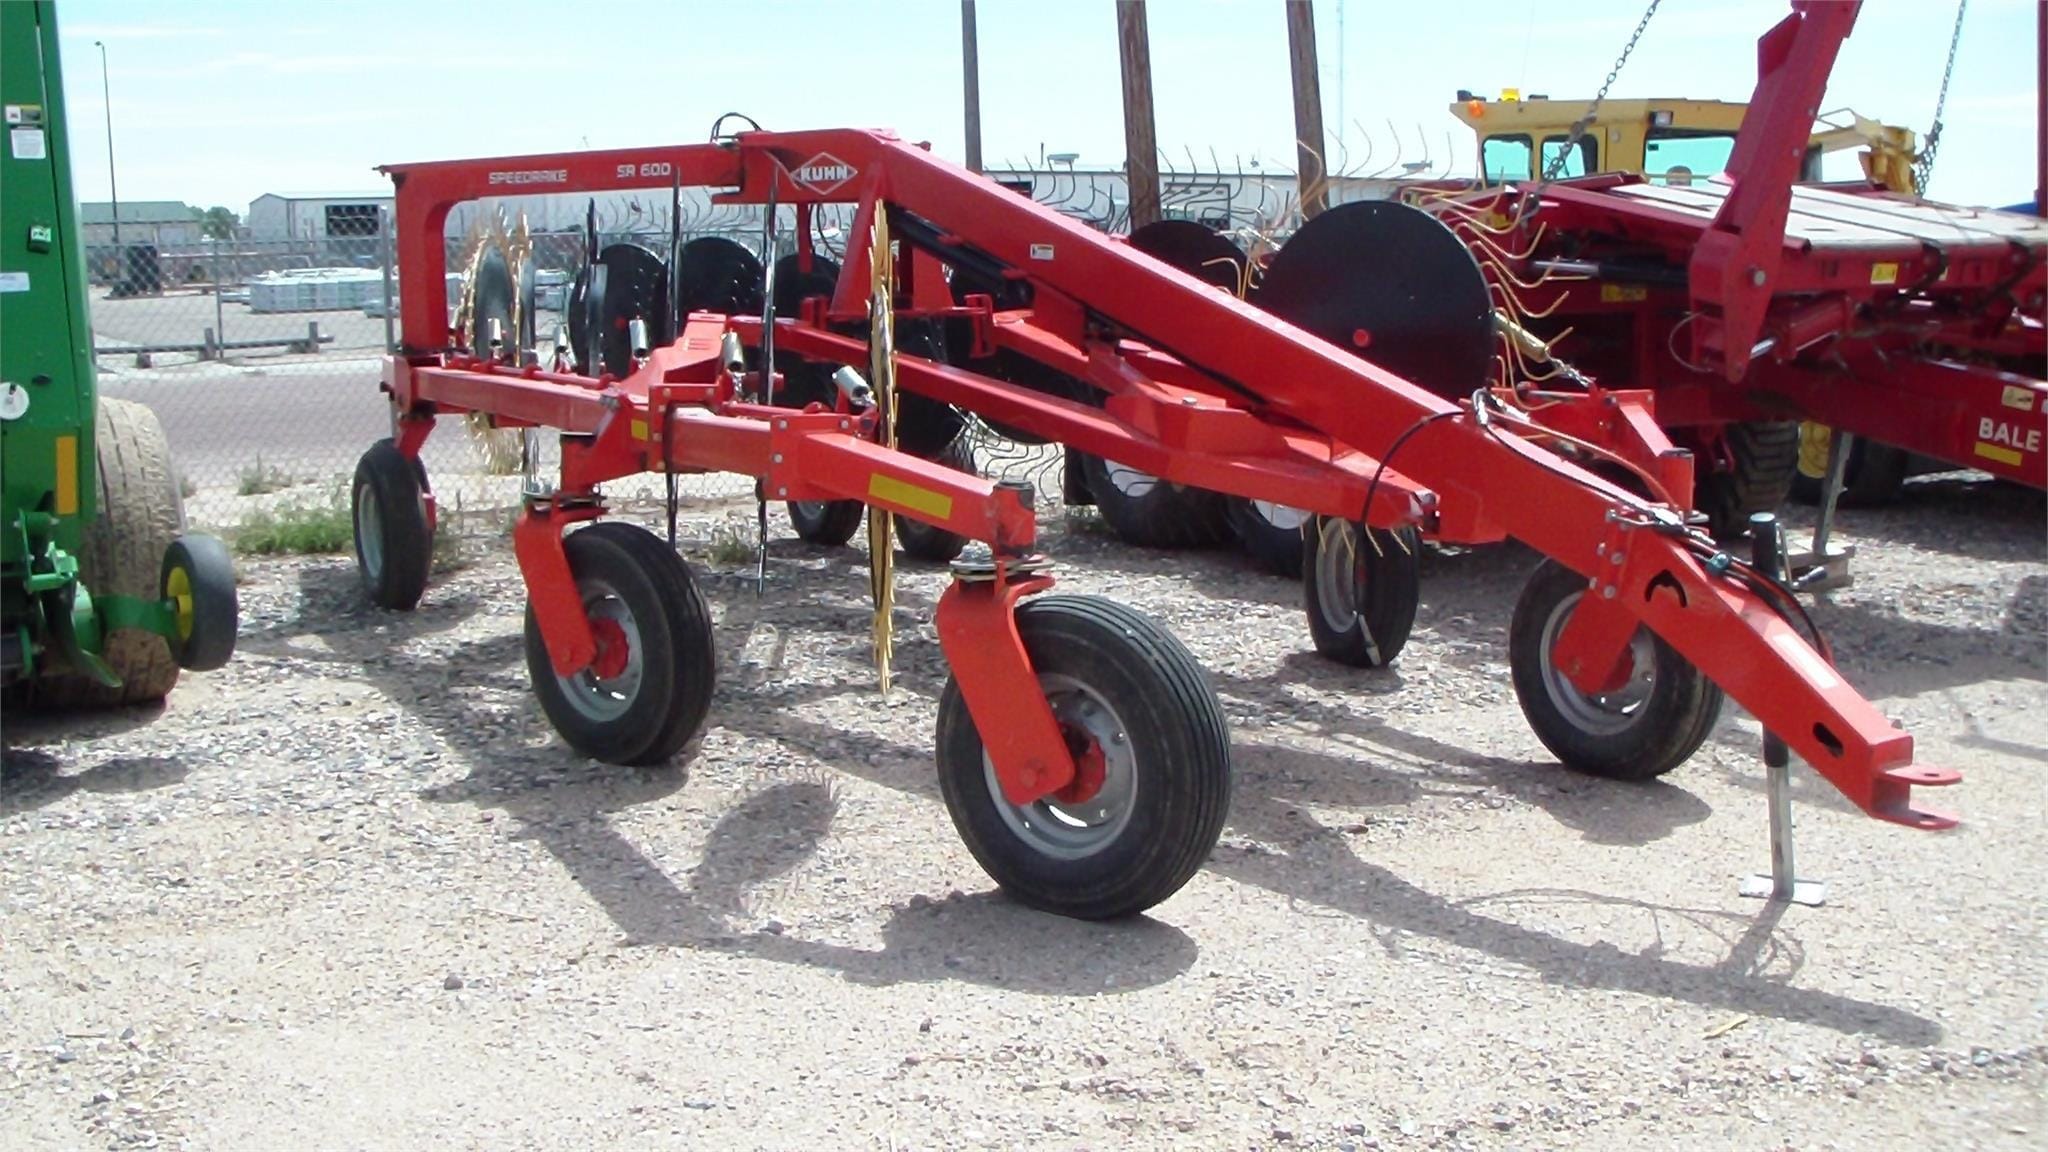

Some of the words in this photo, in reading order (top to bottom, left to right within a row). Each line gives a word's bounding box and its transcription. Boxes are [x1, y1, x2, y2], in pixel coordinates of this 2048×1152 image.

[489, 169, 567, 185] SPEEDRAKE
[616, 164, 636, 178] SR
[640, 162, 671, 177] 600
[800, 165, 848, 181] KUHN
[1978, 416, 2041, 453] BALE
